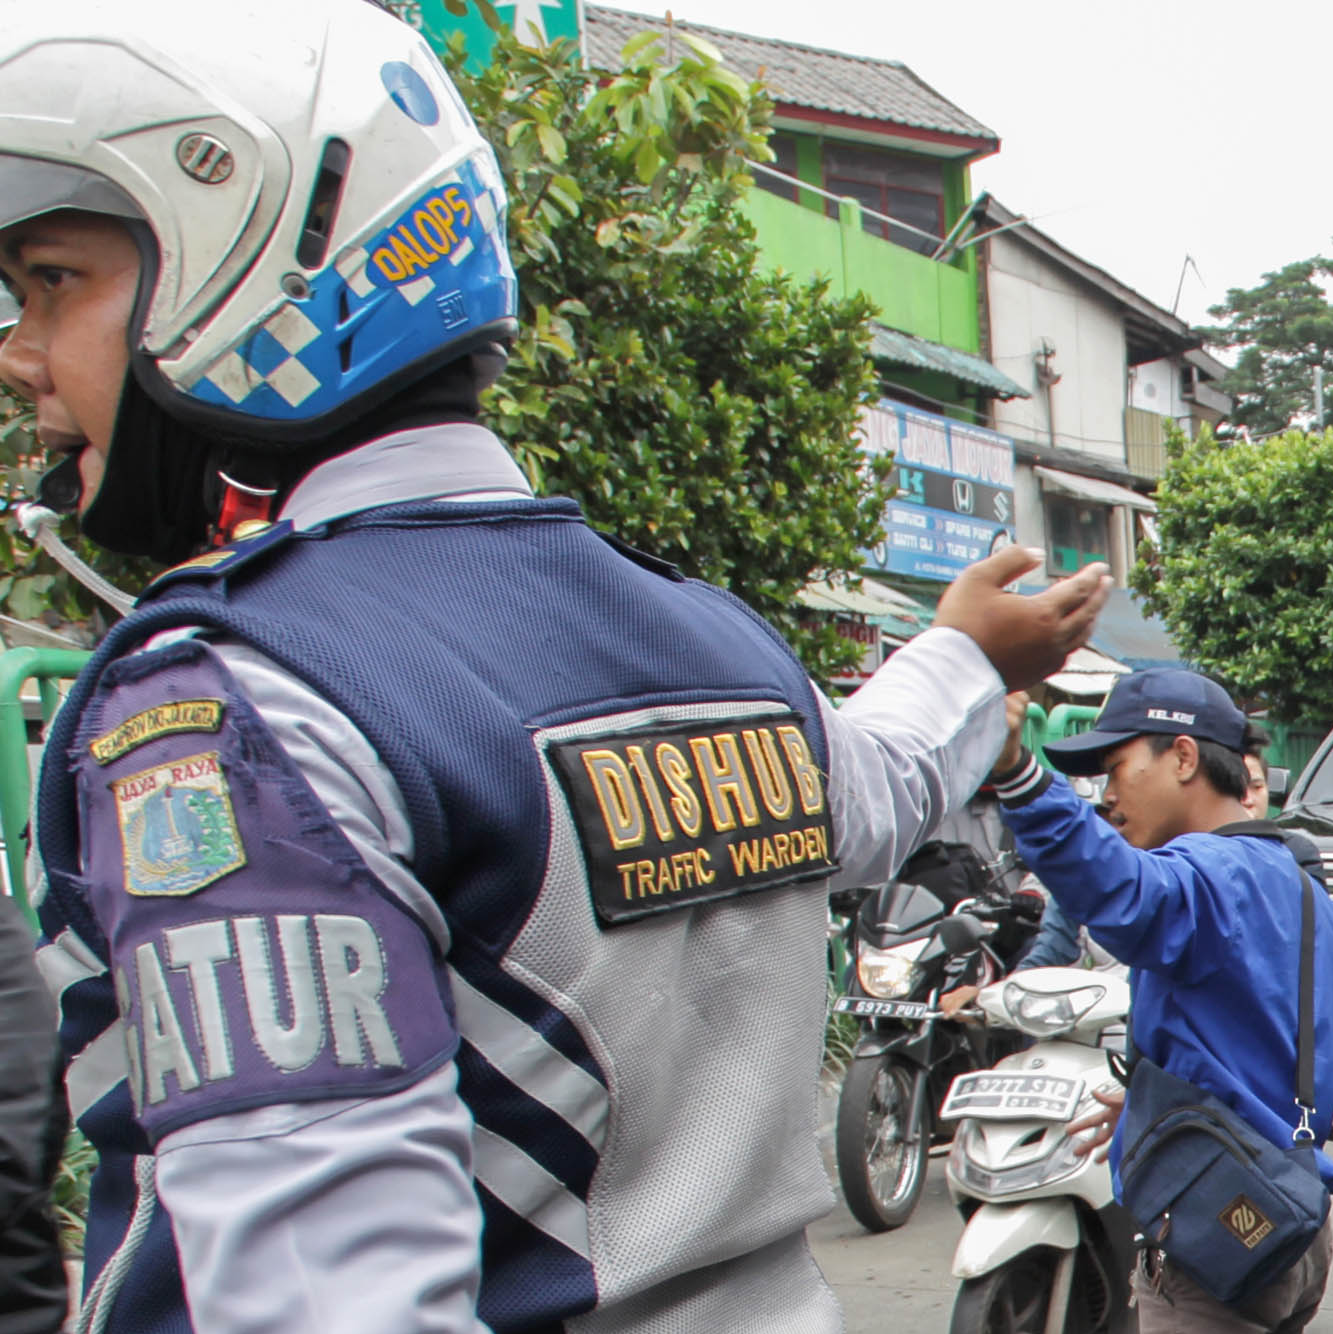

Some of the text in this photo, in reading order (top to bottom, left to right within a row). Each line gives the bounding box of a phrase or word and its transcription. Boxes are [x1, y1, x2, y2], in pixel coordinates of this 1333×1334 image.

[371, 186, 472, 281] DALOPS
[951, 424, 1015, 488] MOTOR
[120, 757, 219, 801] JAYA RAYA
[580, 725, 824, 852] DISHUB
[616, 825, 829, 900] TRAFFIC WARDEN
[837, 999, 849, 1012] B
[895, 1004, 925, 1018] PUY
